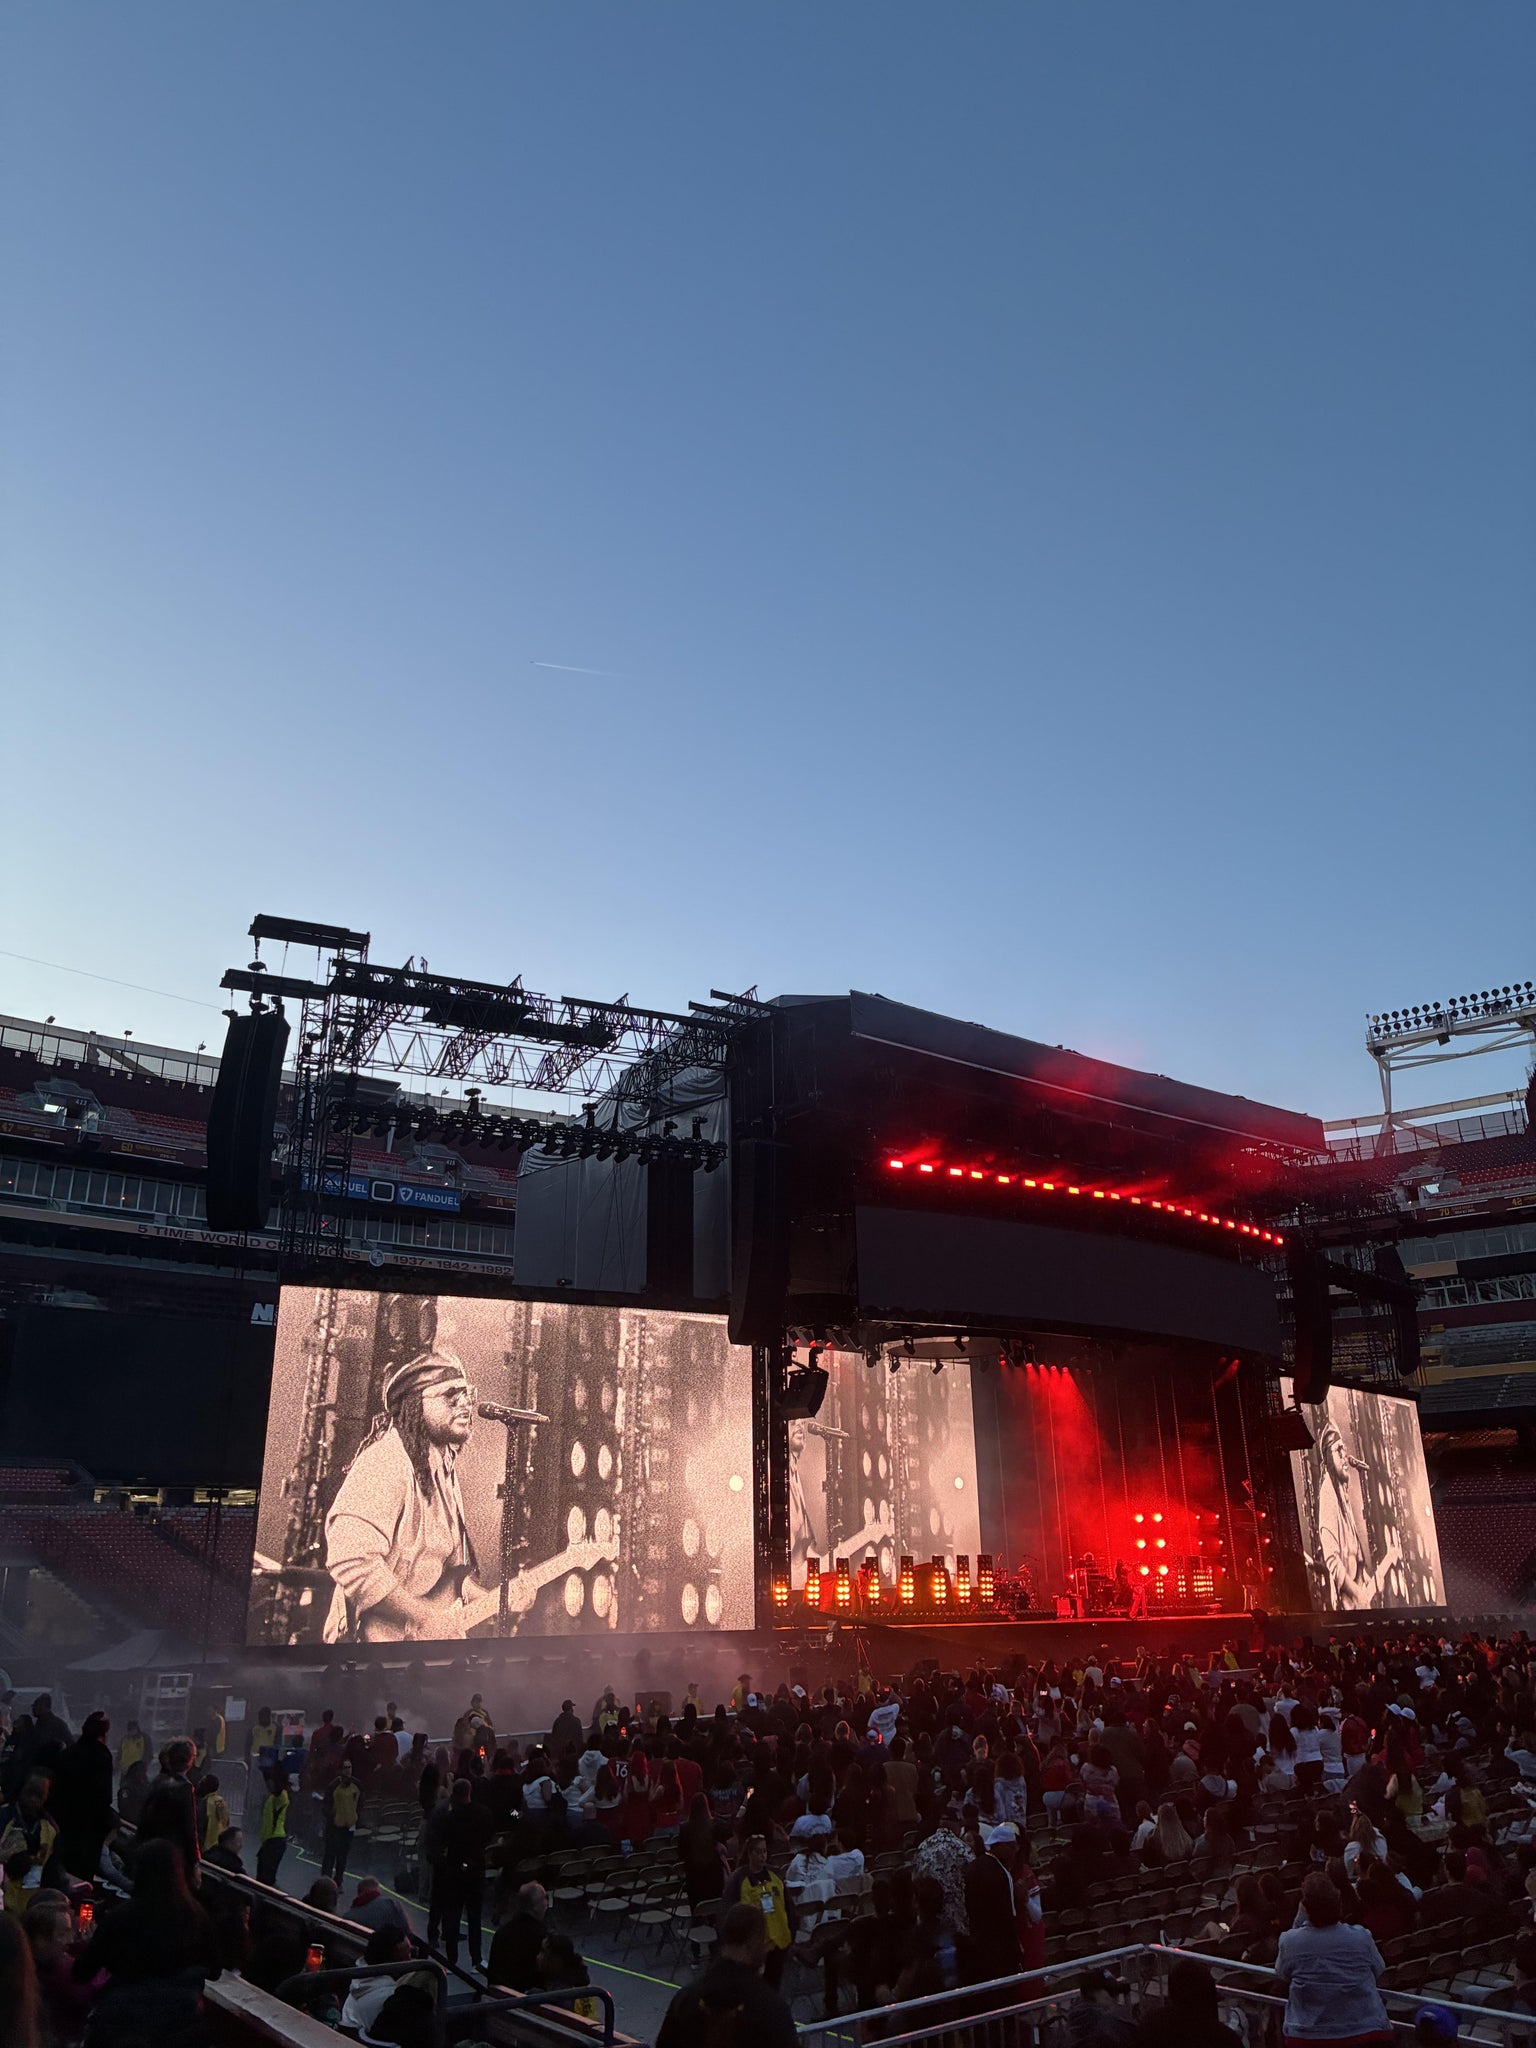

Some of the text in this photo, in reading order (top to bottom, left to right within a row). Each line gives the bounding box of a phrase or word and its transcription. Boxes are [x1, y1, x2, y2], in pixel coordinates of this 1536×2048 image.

[121, 1142, 133, 1153] 60
[414, 1192, 460, 1207] FANDUEL
[137, 1224, 361, 1259] 5 TIME WORLD CIONS
[393, 1255, 426, 1266] 1937
[481, 1265, 512, 1275] 1982
[615, 1763, 629, 1778] 16
